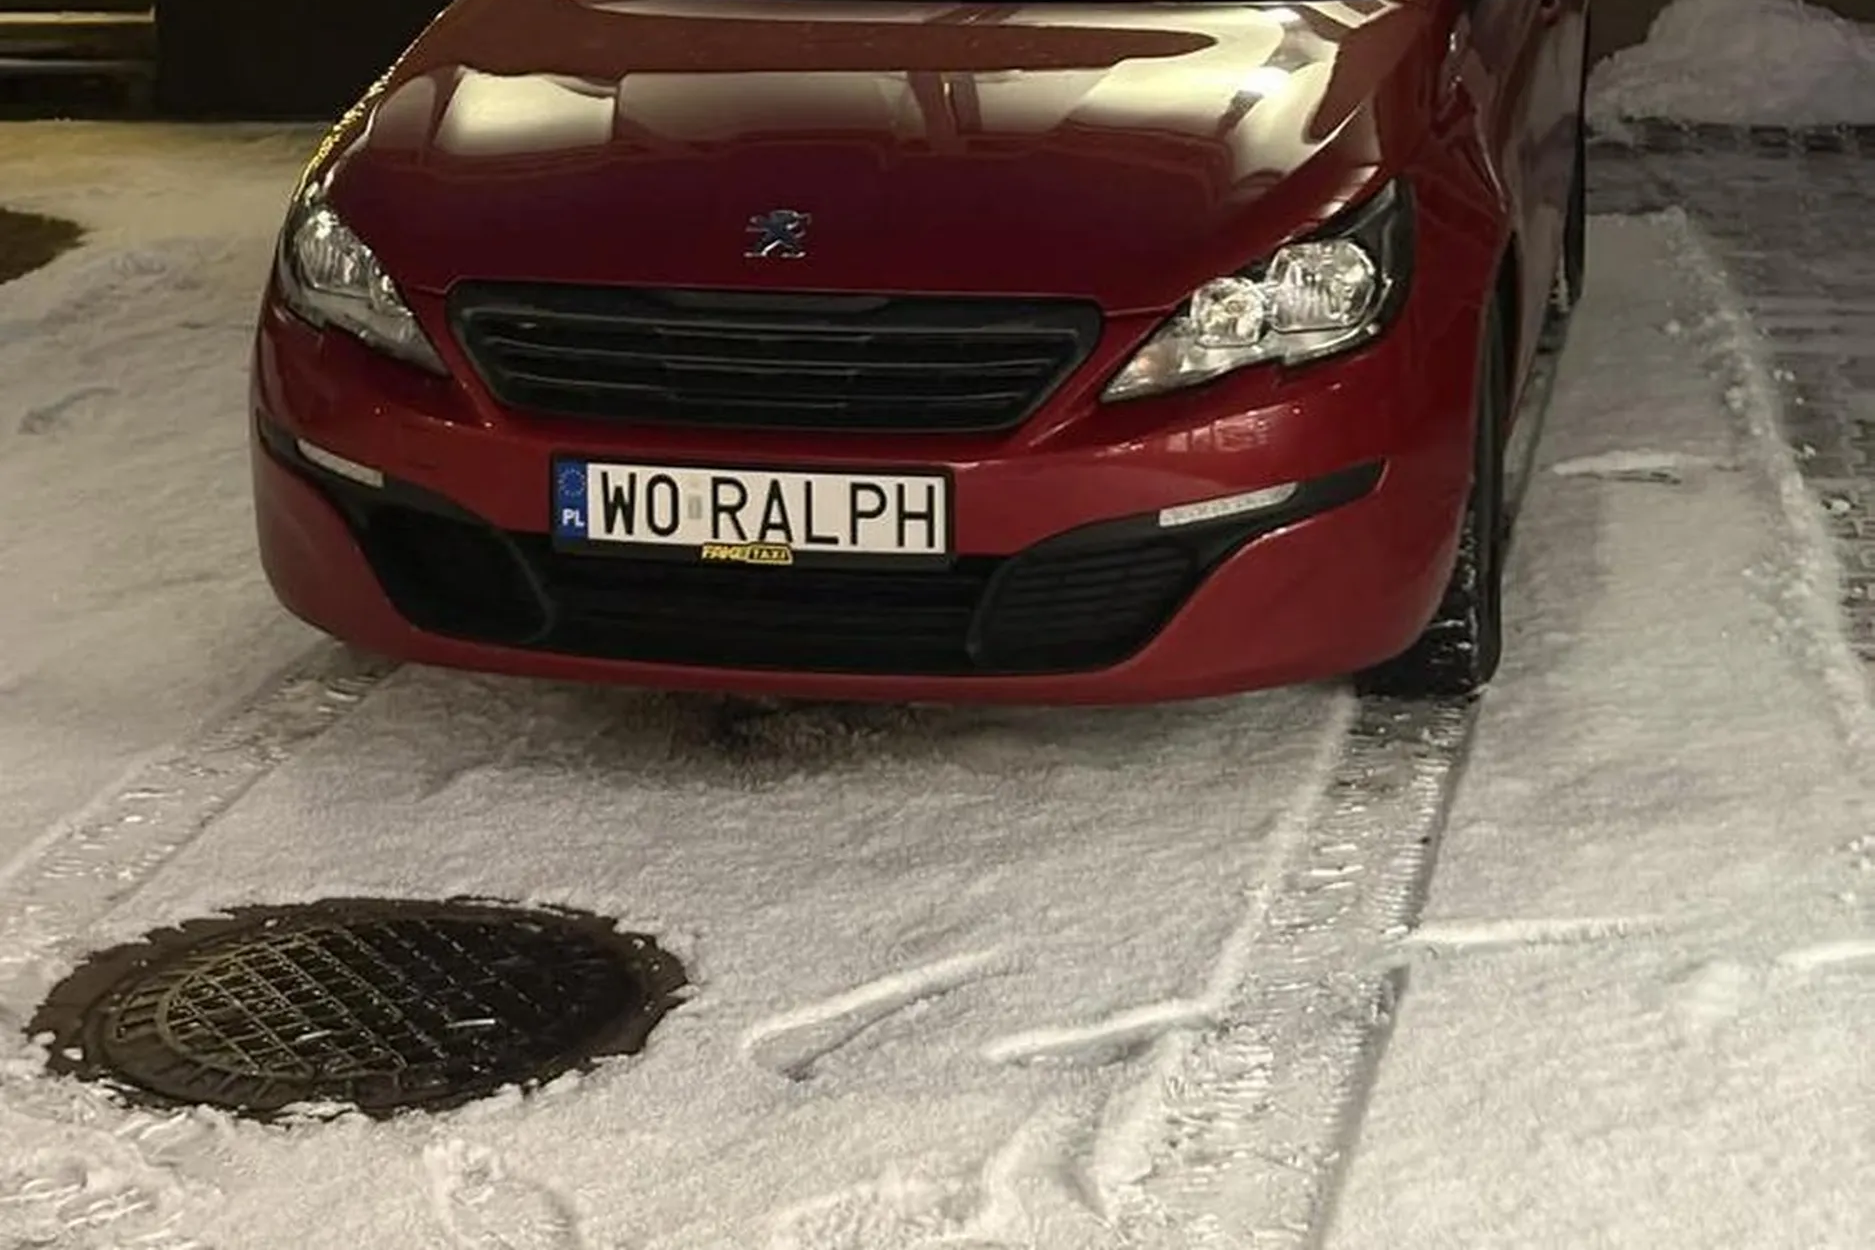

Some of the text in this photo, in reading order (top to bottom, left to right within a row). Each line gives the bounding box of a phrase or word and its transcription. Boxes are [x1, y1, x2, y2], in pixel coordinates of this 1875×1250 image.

[562, 508, 586, 527] PL
[601, 471, 936, 548] WO RALPH
